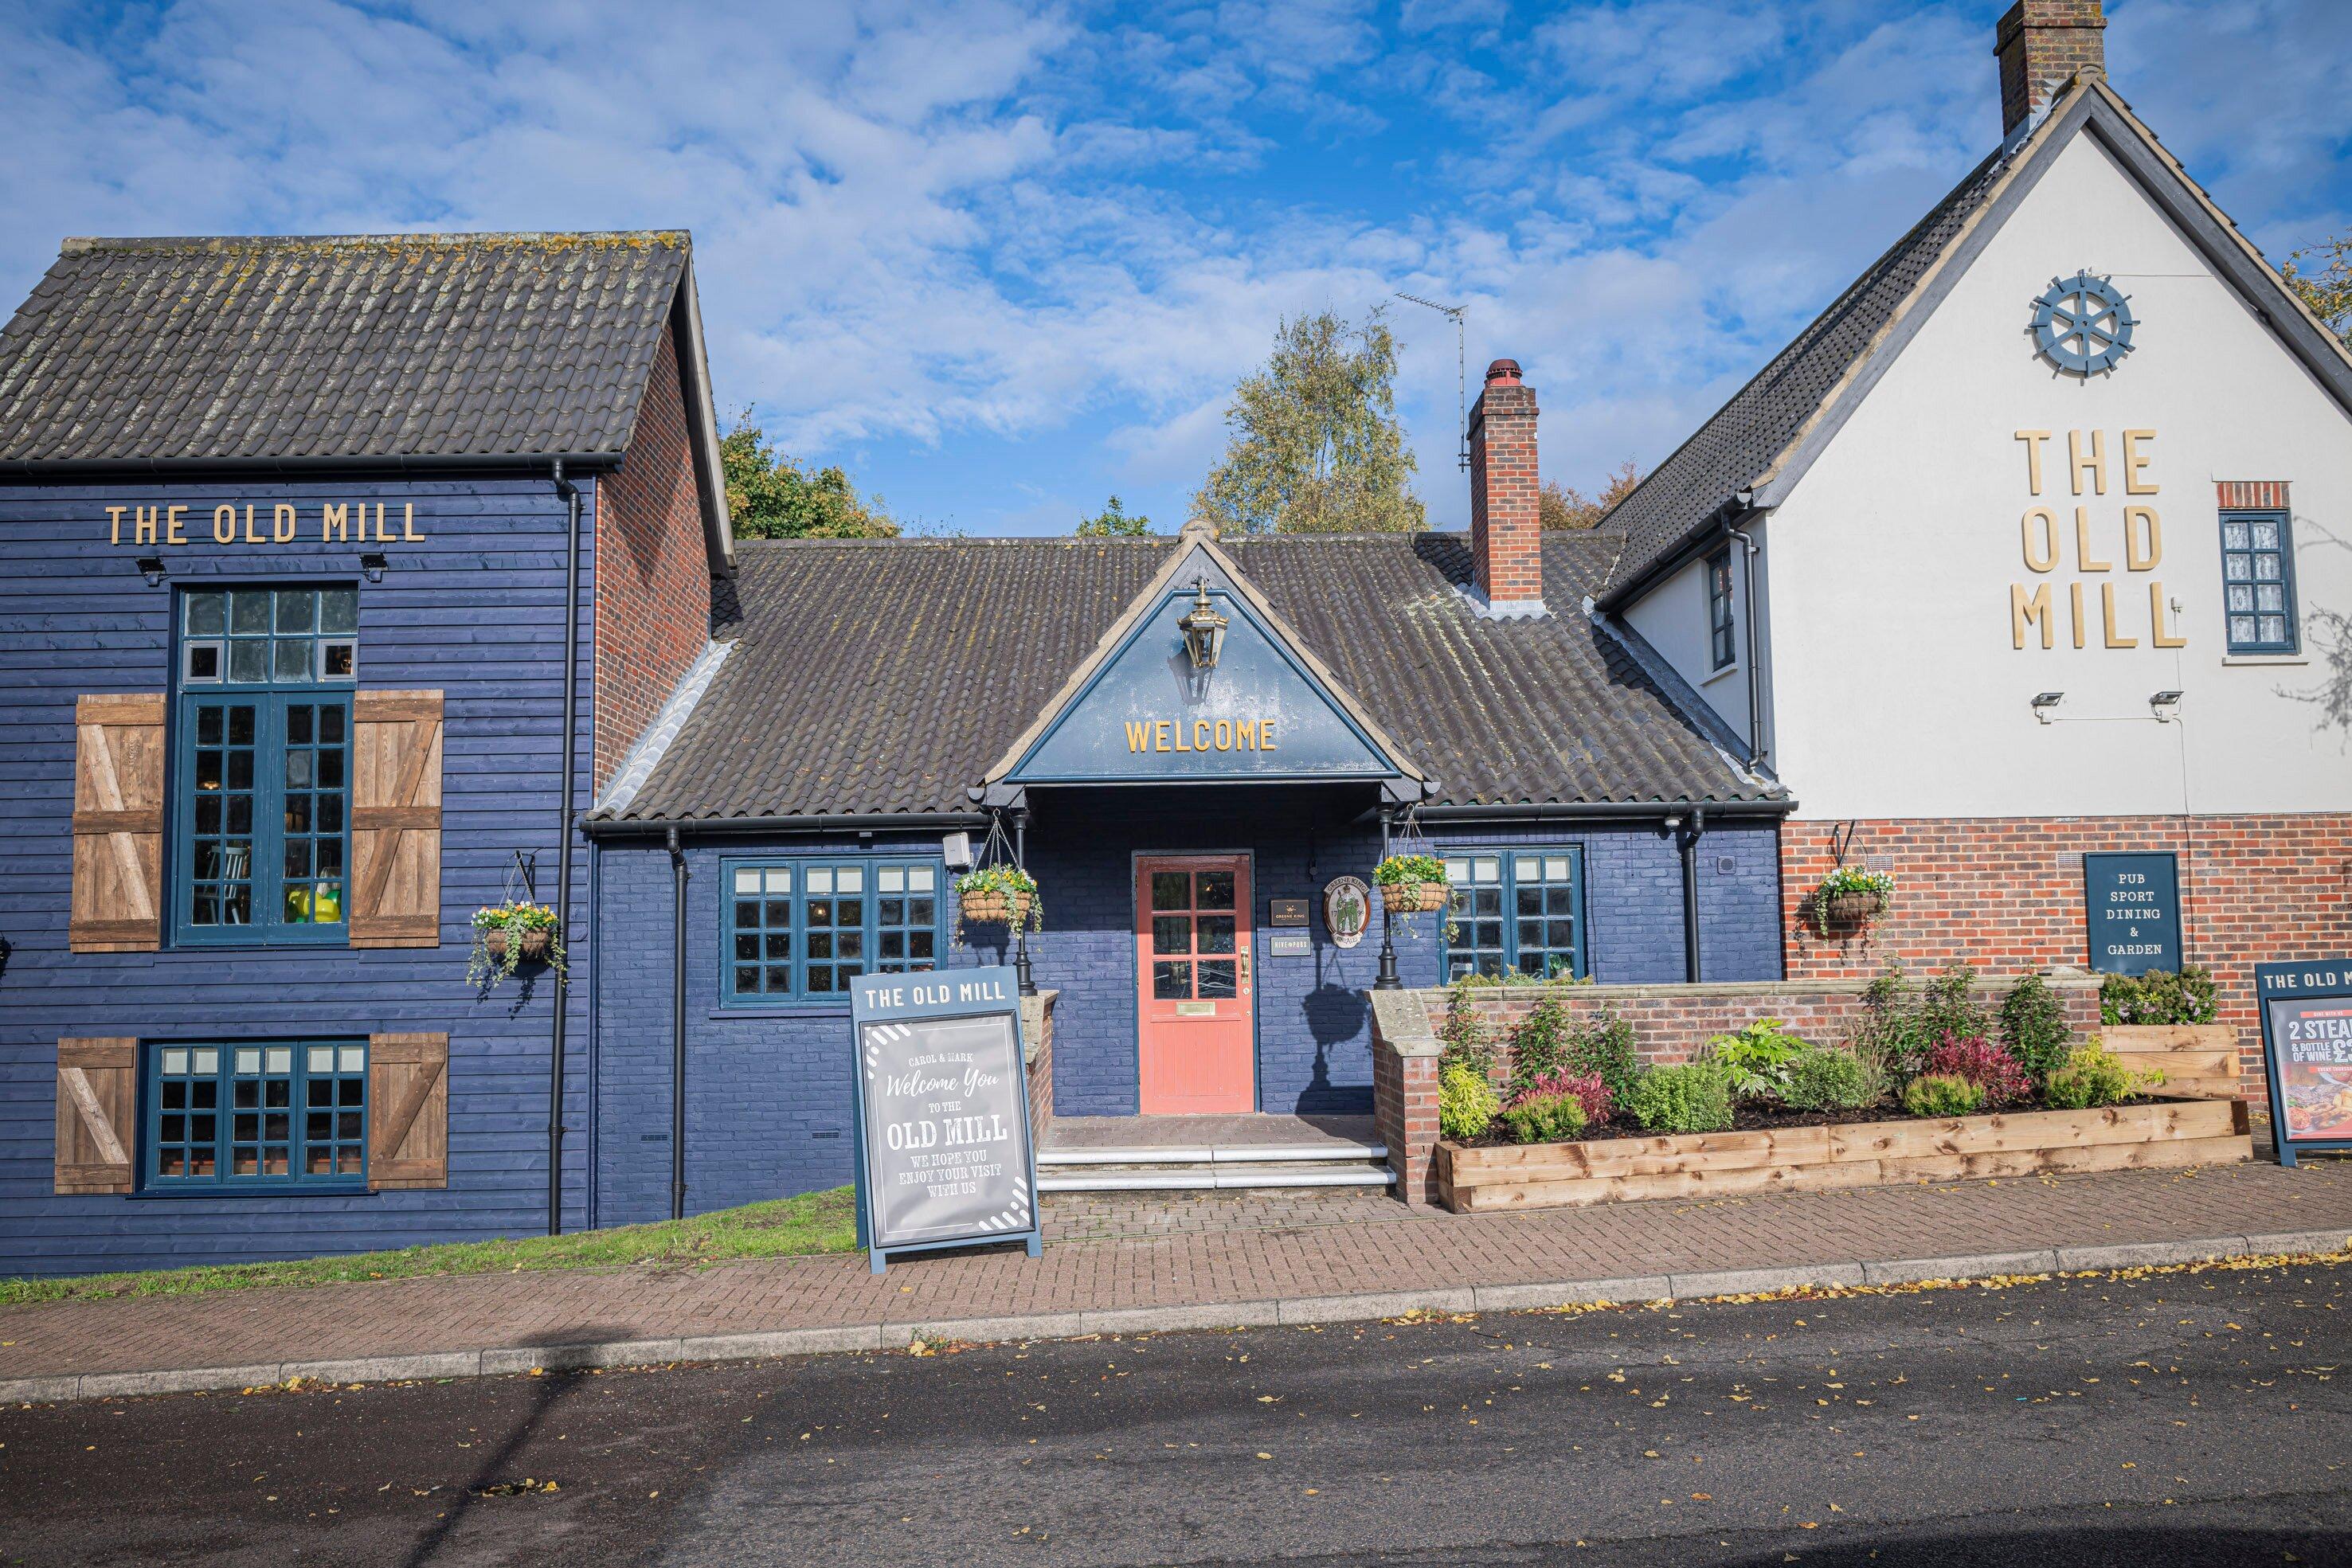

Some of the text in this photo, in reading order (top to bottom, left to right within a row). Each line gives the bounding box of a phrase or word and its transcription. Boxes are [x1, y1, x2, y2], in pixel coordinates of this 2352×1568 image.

[2014, 429, 2159, 495] THE
[105, 502, 425, 545] THE OLD MILL
[2021, 505, 2162, 573] OLD
[2011, 581, 2187, 649] MILL
[1125, 719, 1276, 753] WELCOME
[1327, 877, 1367, 892] GREENE KING
[2119, 874, 2145, 884] PUB
[2111, 891, 2154, 901] SPORT
[2106, 909, 2161, 920] DINING
[2130, 927, 2139, 936] &
[2107, 944, 2162, 955] GARDEN
[2264, 974, 2297, 988] THE
[2303, 972, 2337, 987] OLD
[865, 982, 1006, 1009] THE OLD MILL
[2288, 1019, 2352, 1040] 2 STEA
[2291, 1042, 2331, 1052] & BOTTLE
[908, 1053, 974, 1067] CAROL & MARK
[2293, 1051, 2332, 1062] OF WINE
[886, 1067, 1000, 1097] Welcome You
[929, 1101, 961, 1113] TO THE
[886, 1114, 1008, 1151] OLD MILL
[910, 1149, 987, 1168] WE HOPE YOU
[898, 1163, 1002, 1185] ENJOY YOUR VISIT
[926, 1181, 976, 1198] WITH US
